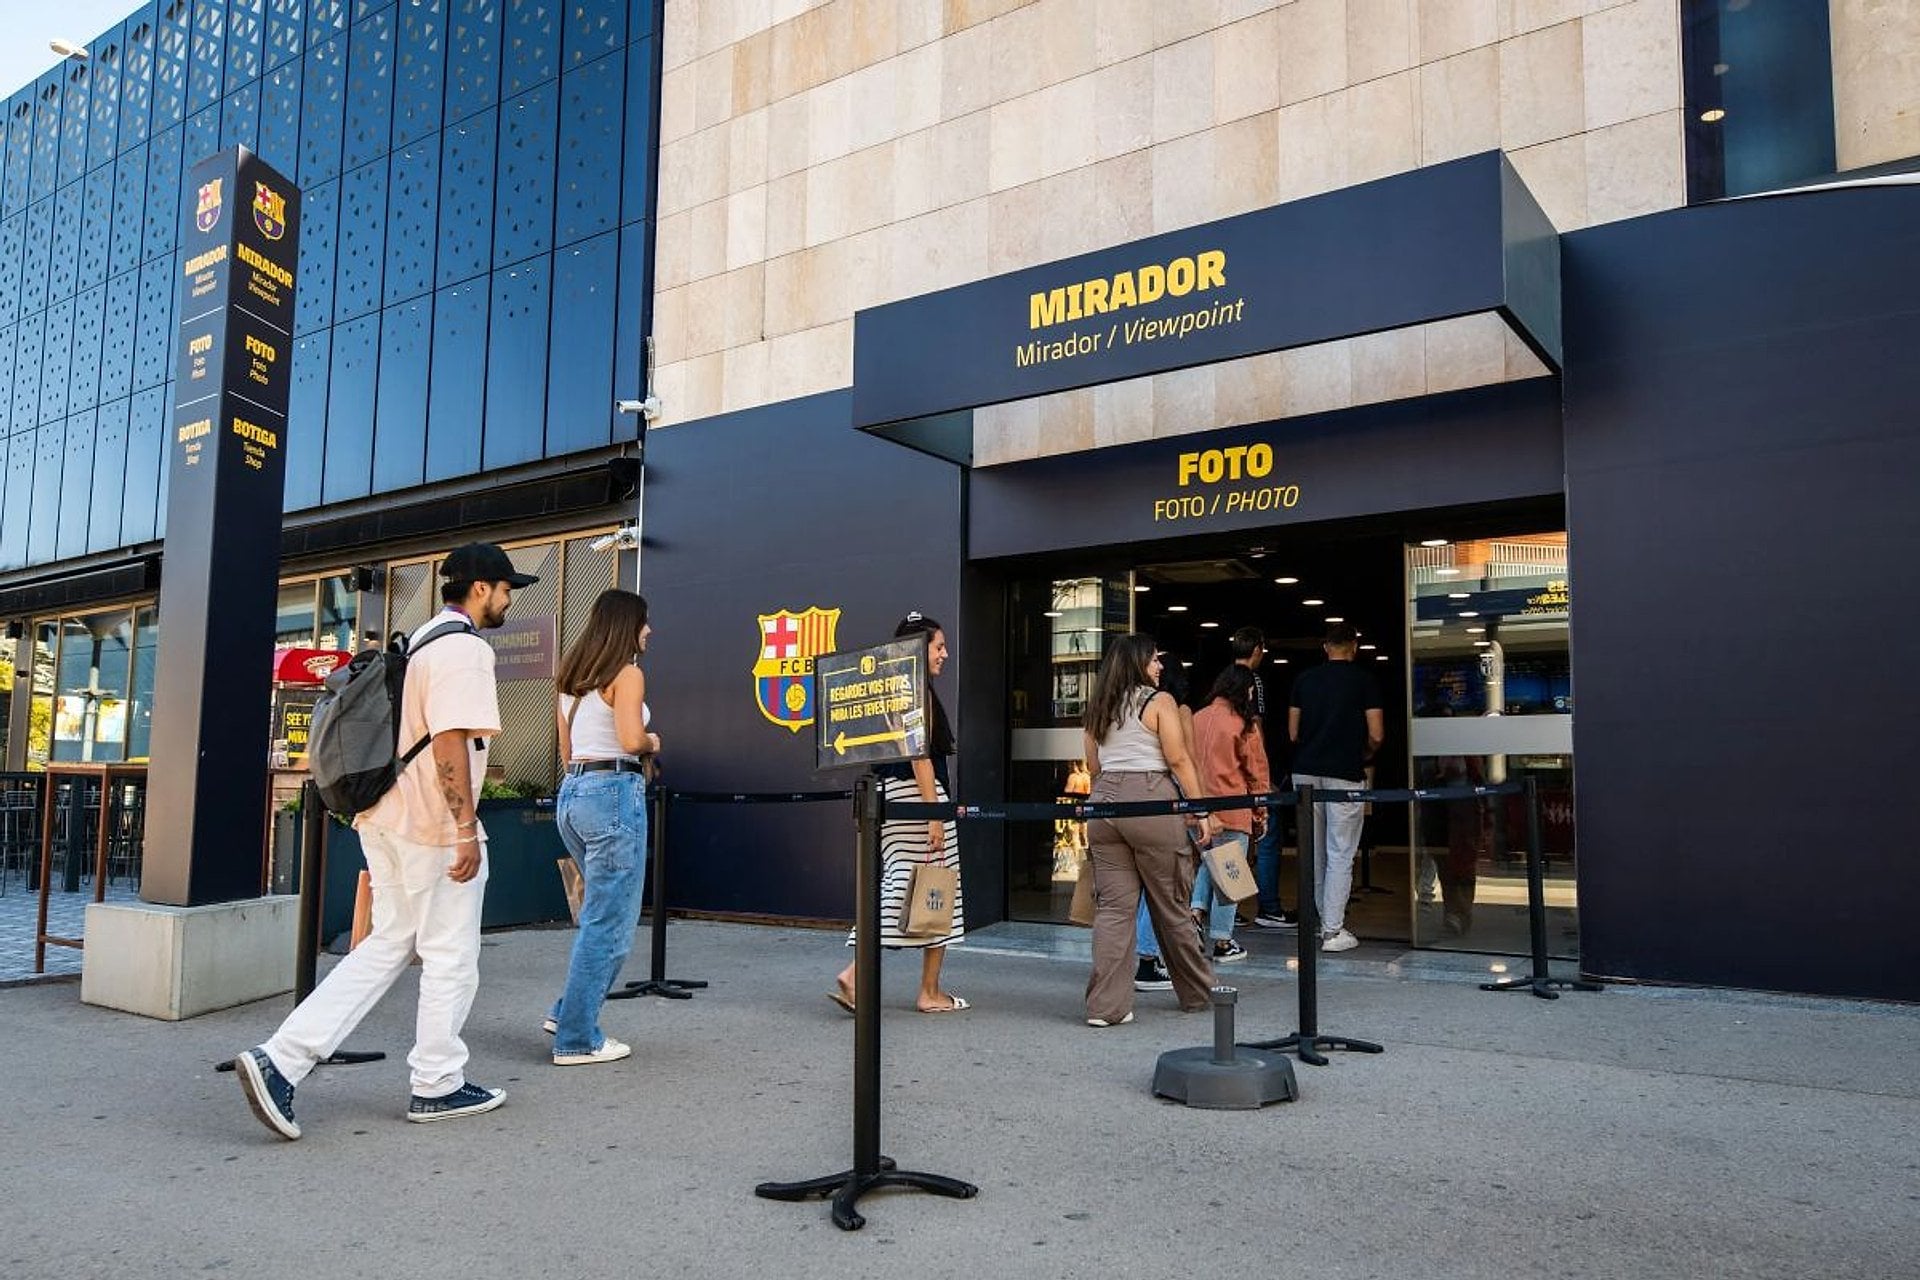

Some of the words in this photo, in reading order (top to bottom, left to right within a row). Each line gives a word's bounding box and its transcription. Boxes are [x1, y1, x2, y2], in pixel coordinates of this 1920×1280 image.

[185, 245, 227, 276] MIRADOR
[238, 243, 293, 289] MIRADOR
[1030, 250, 1226, 330] MIRADOR
[189, 334, 212, 355] FOTO
[246, 335, 275, 362] FOTO
[1016, 332, 1101, 368] Mirador
[1107, 325, 1117, 349] /
[1124, 297, 1245, 345] Viewpoint
[233, 417, 277, 449] BOTIGA
[1178, 443, 1274, 486] FOTO
[1155, 495, 1205, 521] FOTO
[1210, 494, 1220, 515] /
[1225, 486, 1300, 513] PHOTO
